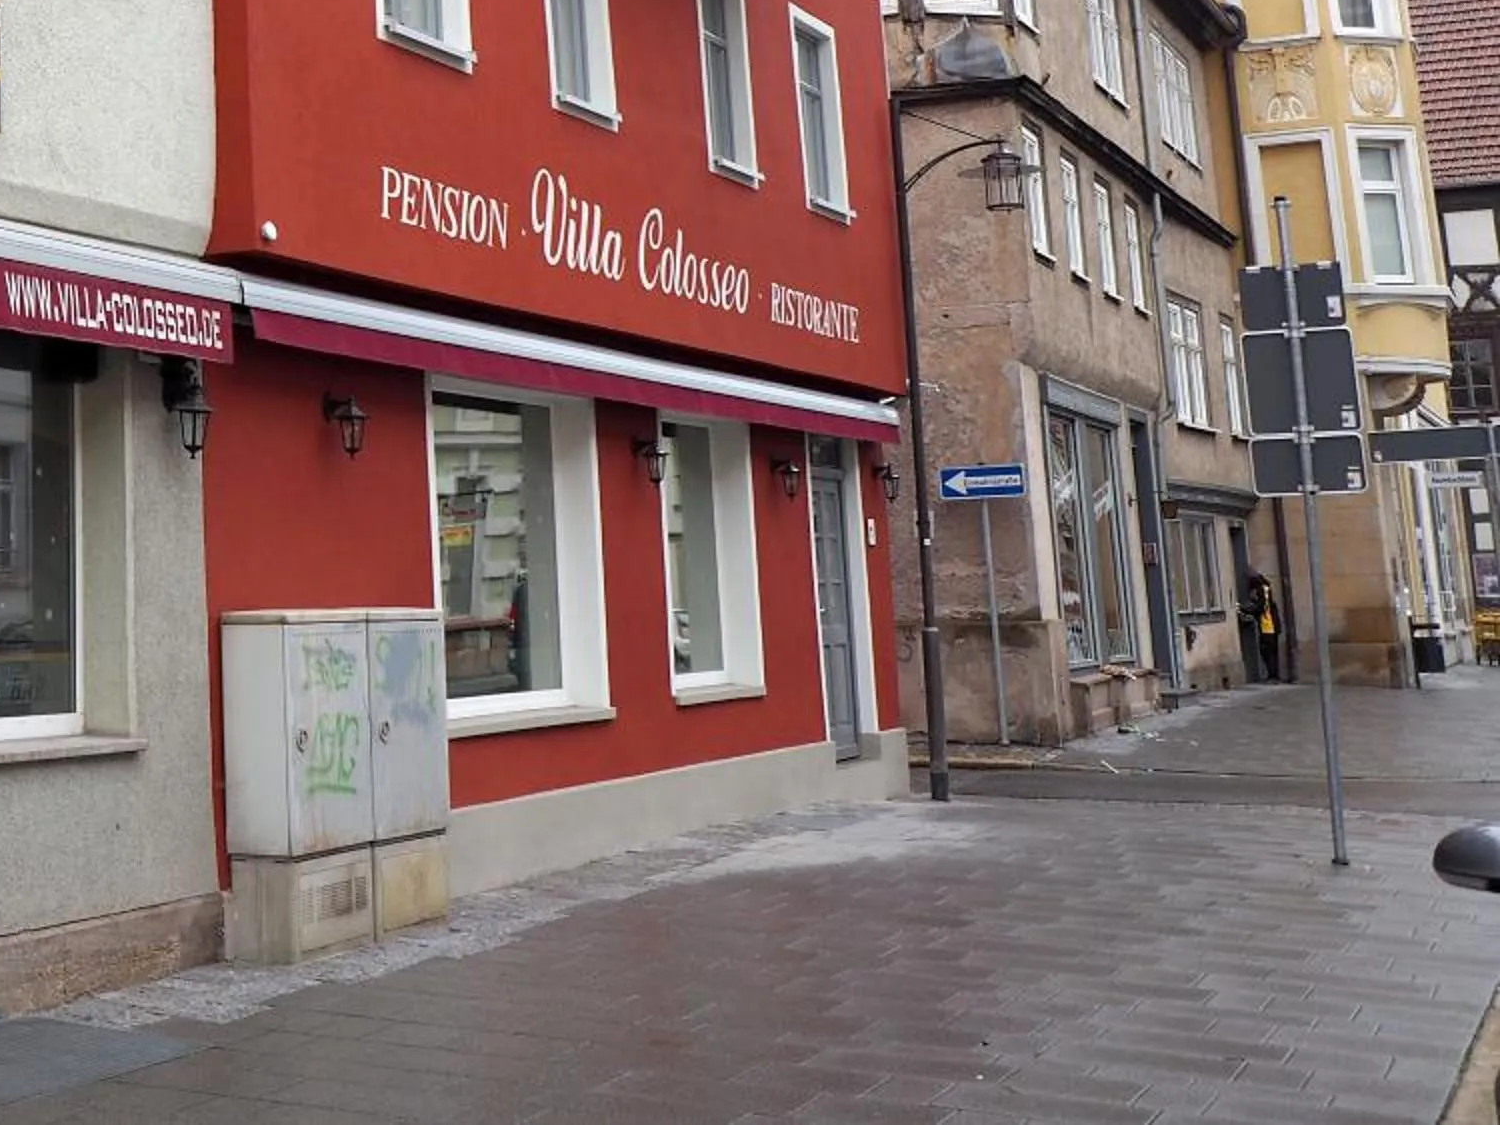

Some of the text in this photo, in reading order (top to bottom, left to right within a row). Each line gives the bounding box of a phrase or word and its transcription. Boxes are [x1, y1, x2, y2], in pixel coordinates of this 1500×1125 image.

[3, 270, 225, 351] WWW.VILLA-COLOSSEO.DE
[381, 165, 860, 344] PENSION Villa Colosseo RISTORANTE
